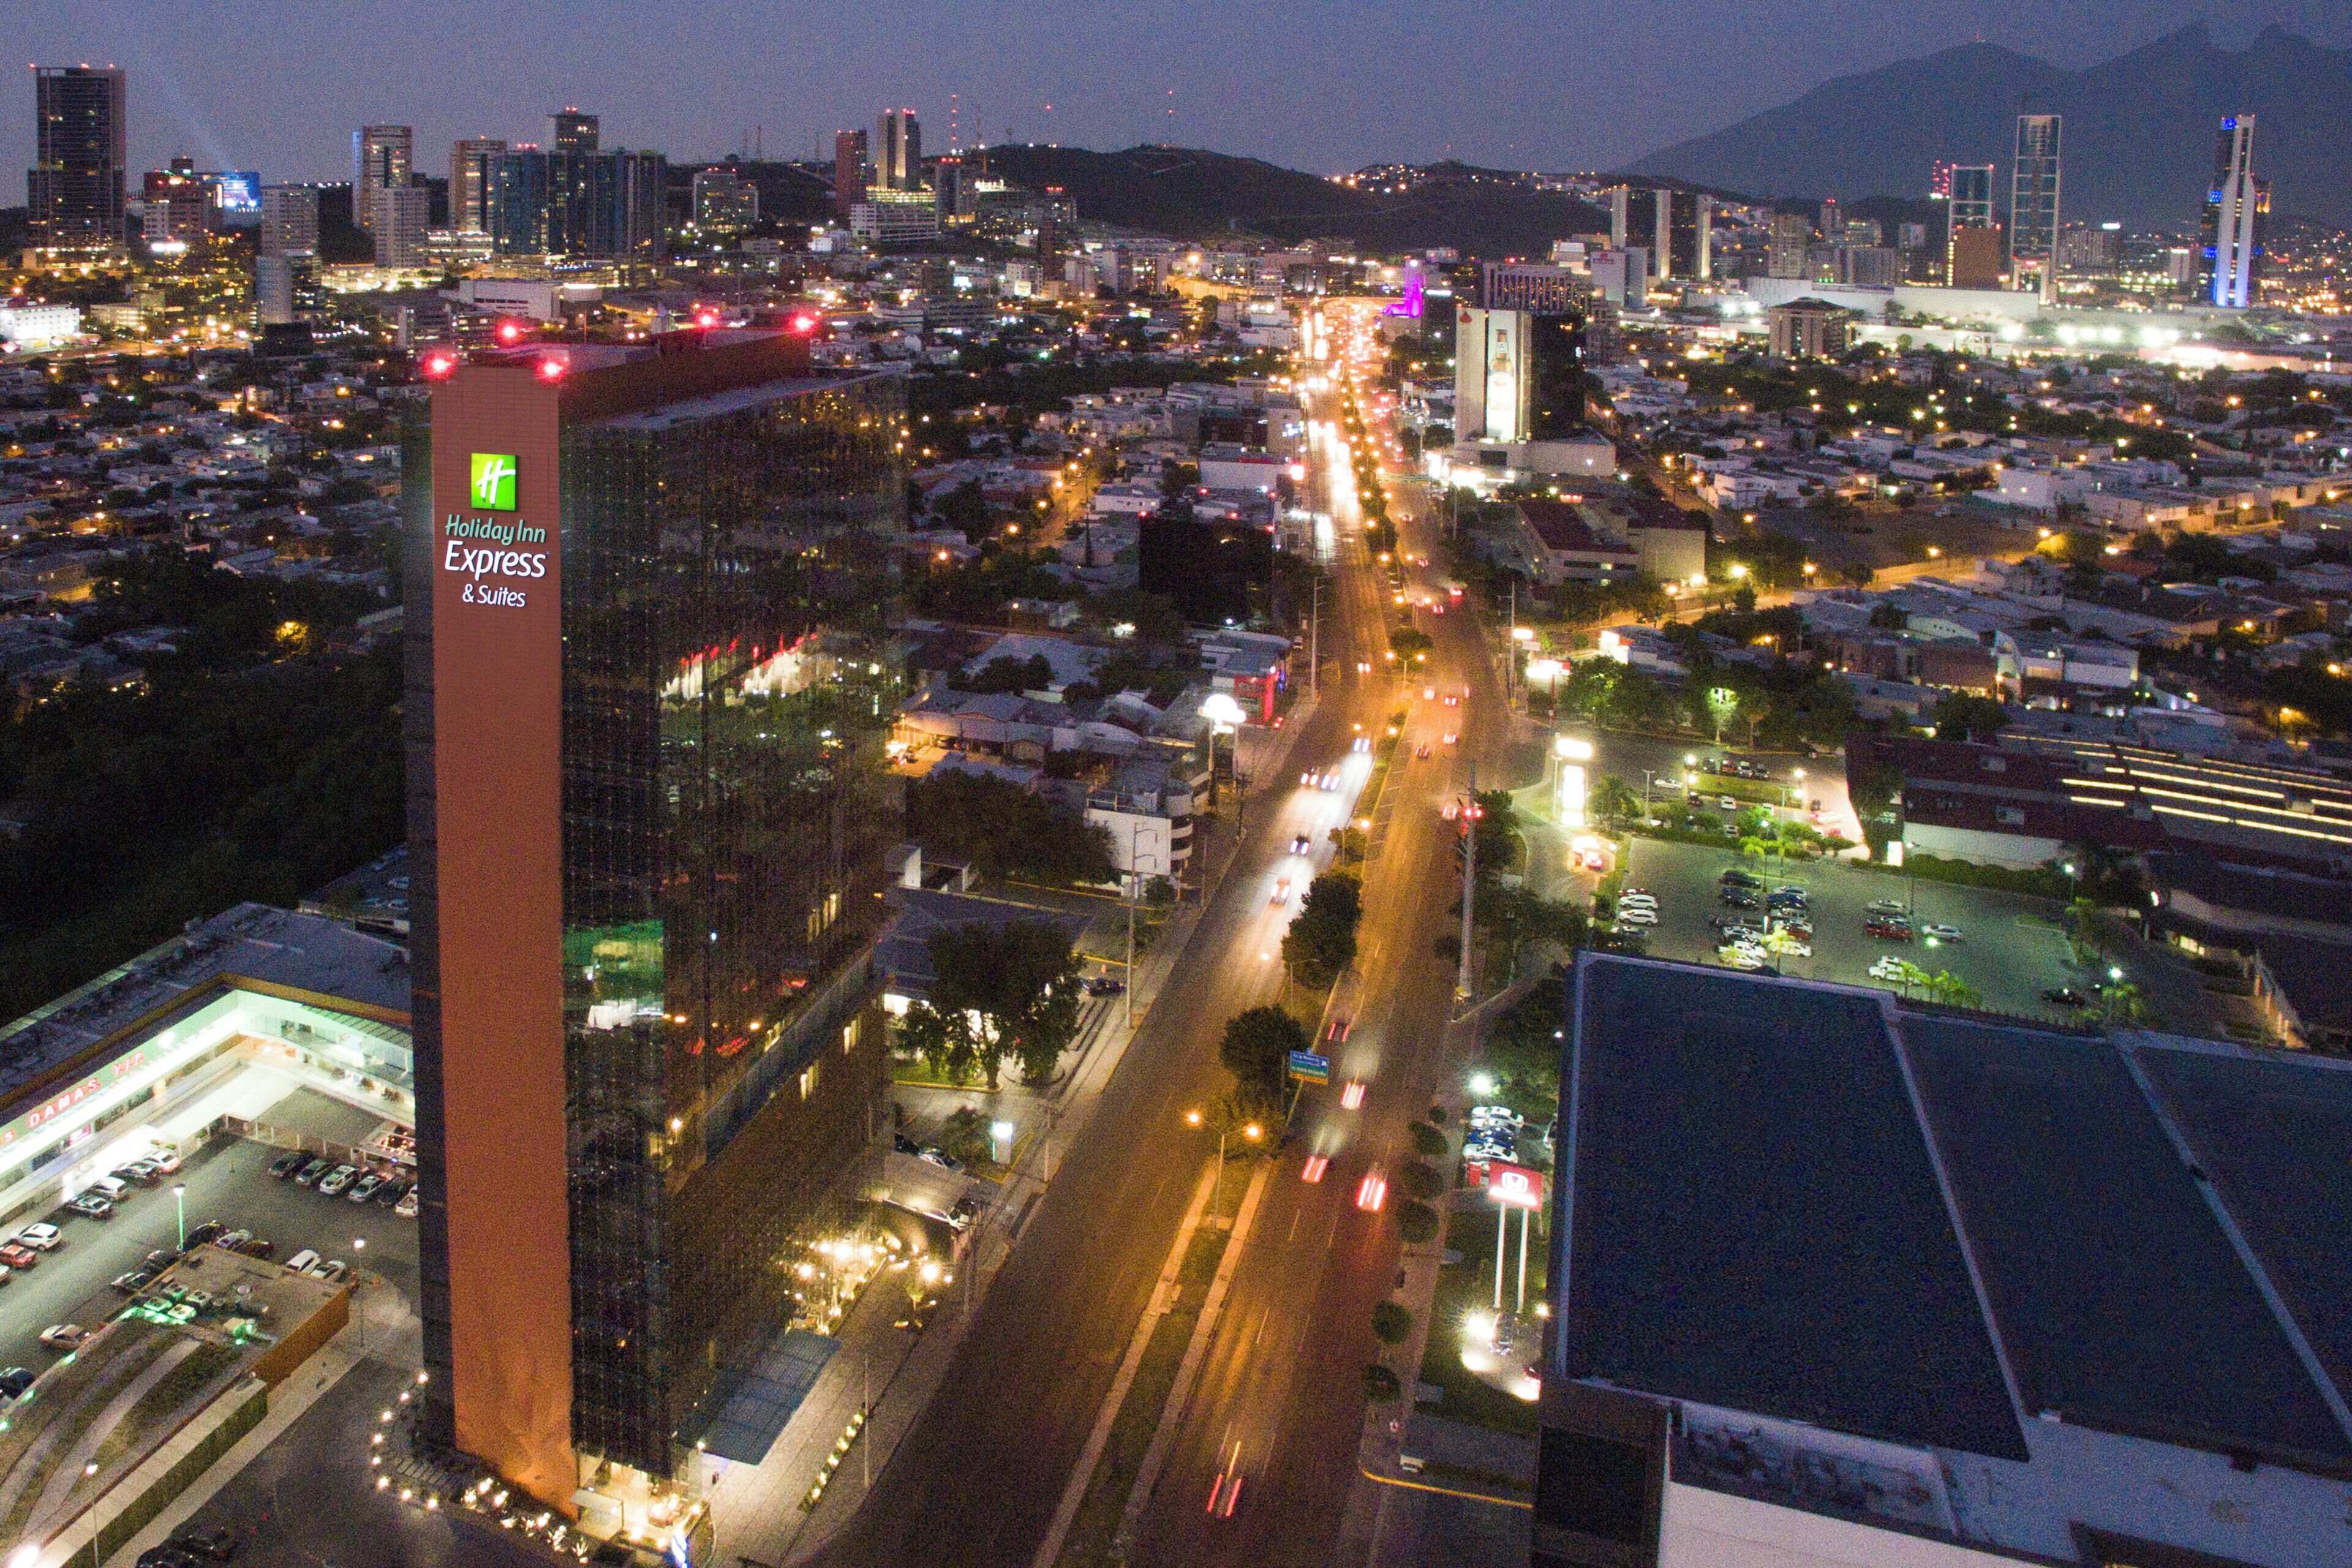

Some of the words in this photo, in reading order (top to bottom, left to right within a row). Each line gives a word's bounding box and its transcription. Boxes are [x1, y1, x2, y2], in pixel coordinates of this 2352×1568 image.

[445, 514, 514, 545] Holiday
[518, 520, 545, 543] Inn
[445, 540, 545, 581] Express
[462, 584, 474, 603] &
[477, 585, 526, 607] Suites
